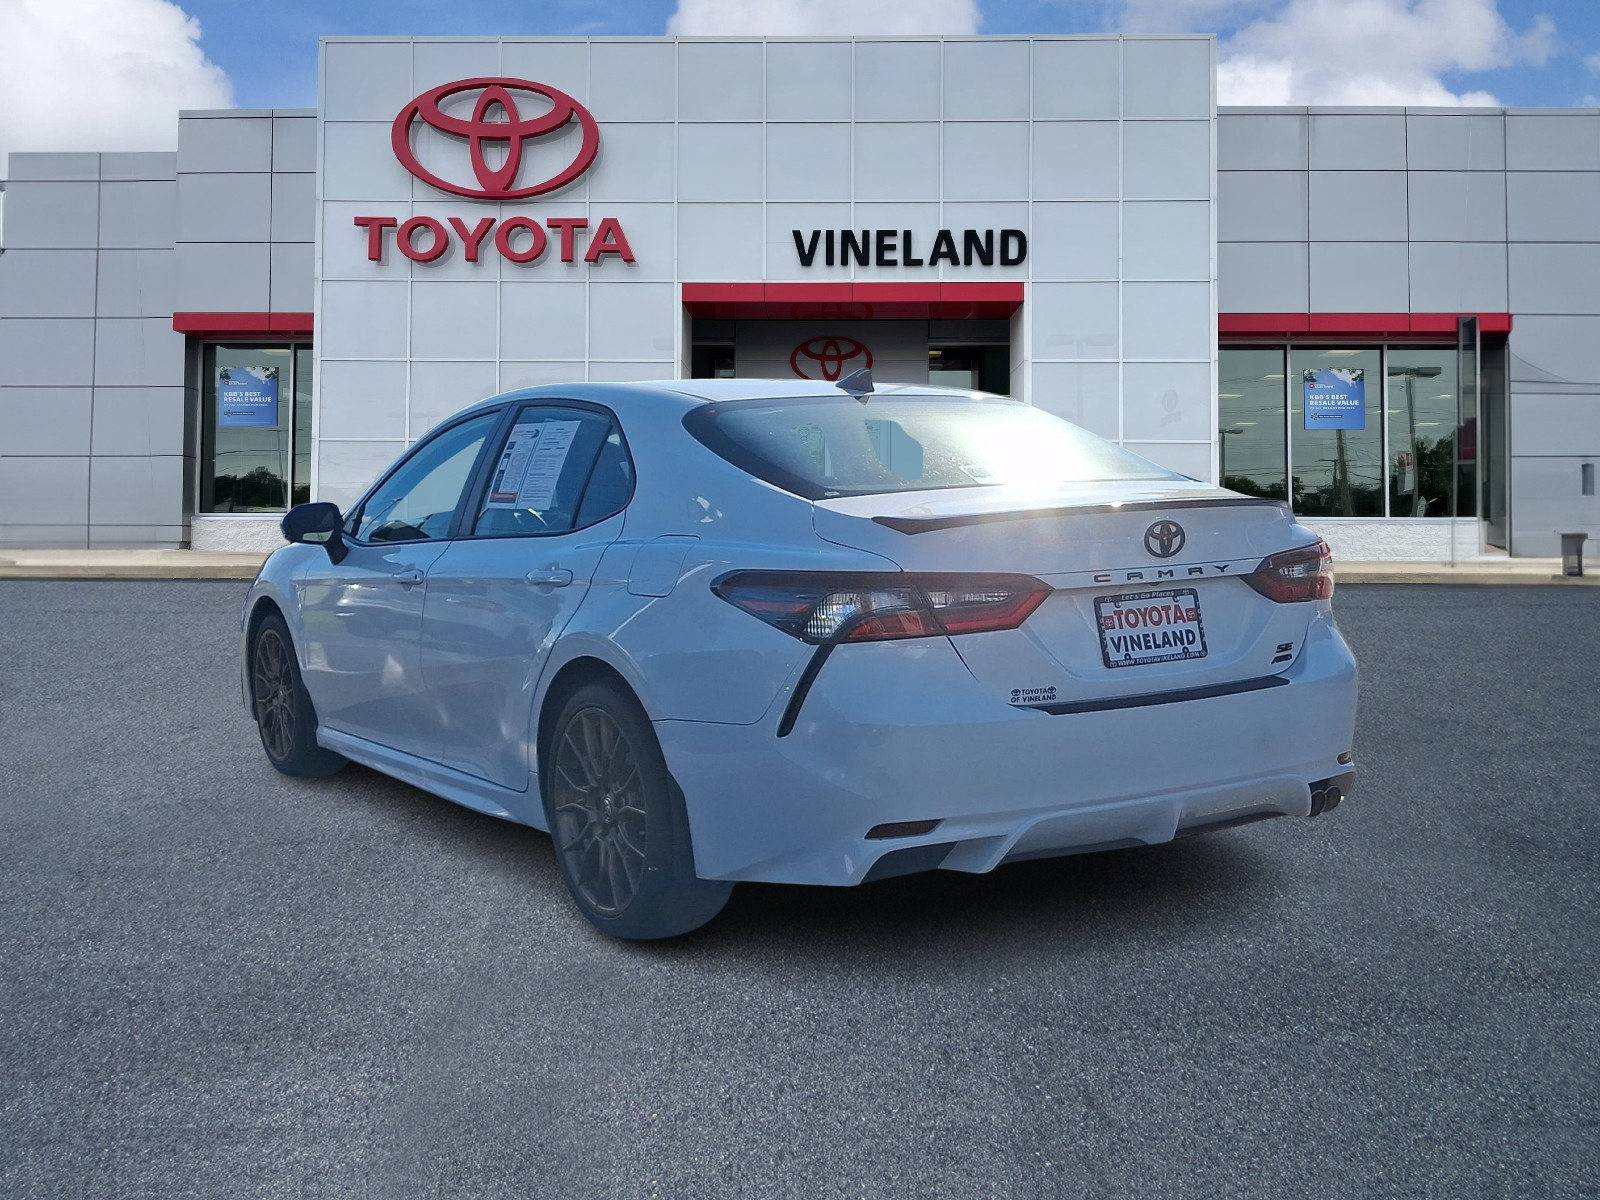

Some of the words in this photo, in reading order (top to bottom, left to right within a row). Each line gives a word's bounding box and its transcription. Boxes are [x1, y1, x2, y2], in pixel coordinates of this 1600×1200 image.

[354, 216, 637, 263] TOYOTA
[792, 229, 1028, 267] VINELAND
[1093, 564, 1230, 583] CAMRY
[1151, 590, 1175, 598] Places
[1113, 604, 1187, 630] TOYOTA
[1109, 629, 1196, 654] VINELAND
[1117, 651, 1200, 667] WWW.TOYOTAVINELAND.COM
[1021, 687, 1048, 695] TOYOTA
[1022, 694, 1057, 703] VINELAND
